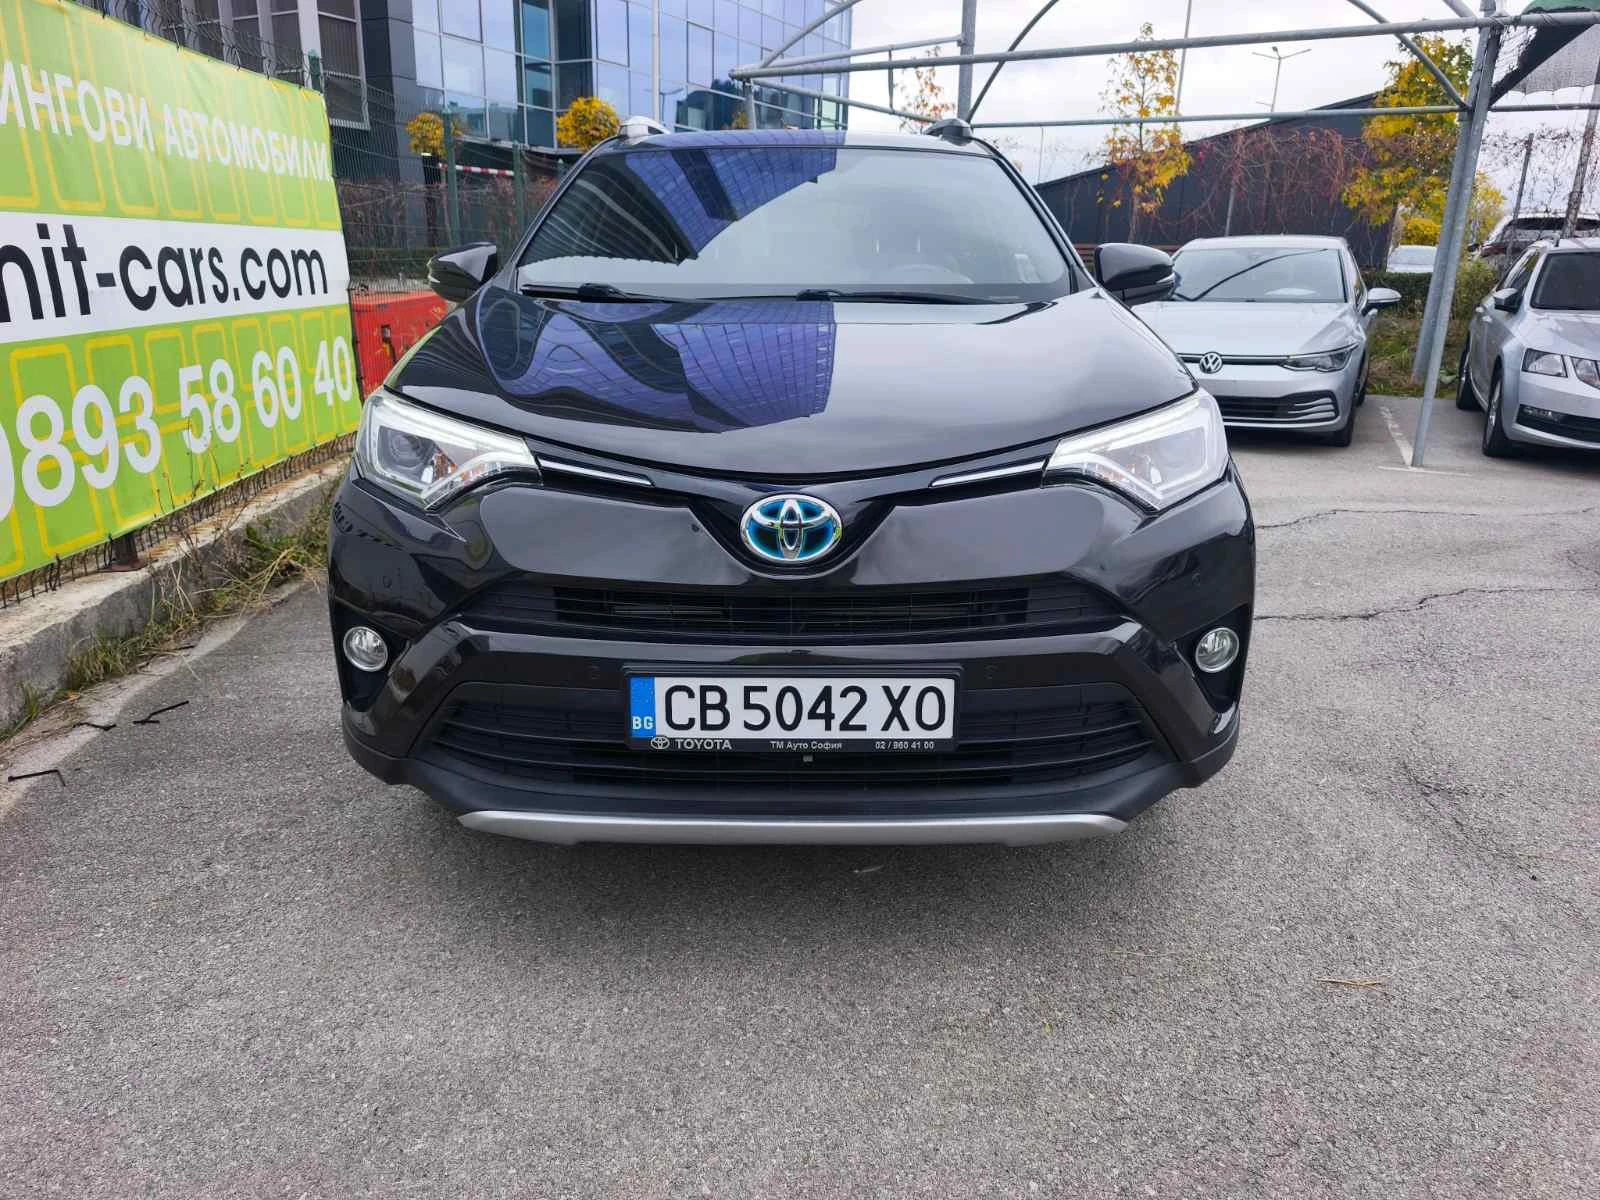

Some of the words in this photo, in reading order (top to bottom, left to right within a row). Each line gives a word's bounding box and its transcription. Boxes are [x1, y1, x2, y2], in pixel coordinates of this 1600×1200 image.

[163, 103, 329, 181] АВТОМОБИЛИ
[179, 358, 241, 454] 58
[252, 346, 301, 428] 60
[313, 336, 351, 406] 40
[665, 684, 731, 732] CB
[743, 685, 867, 732] 5042
[881, 685, 946, 732] XO
[632, 716, 654, 730] BG
[675, 739, 732, 750] TOYOTA
[786, 740, 809, 751] Ауто
[811, 740, 843, 751] София
[875, 740, 886, 750] 02
[911, 740, 921, 750] 41
